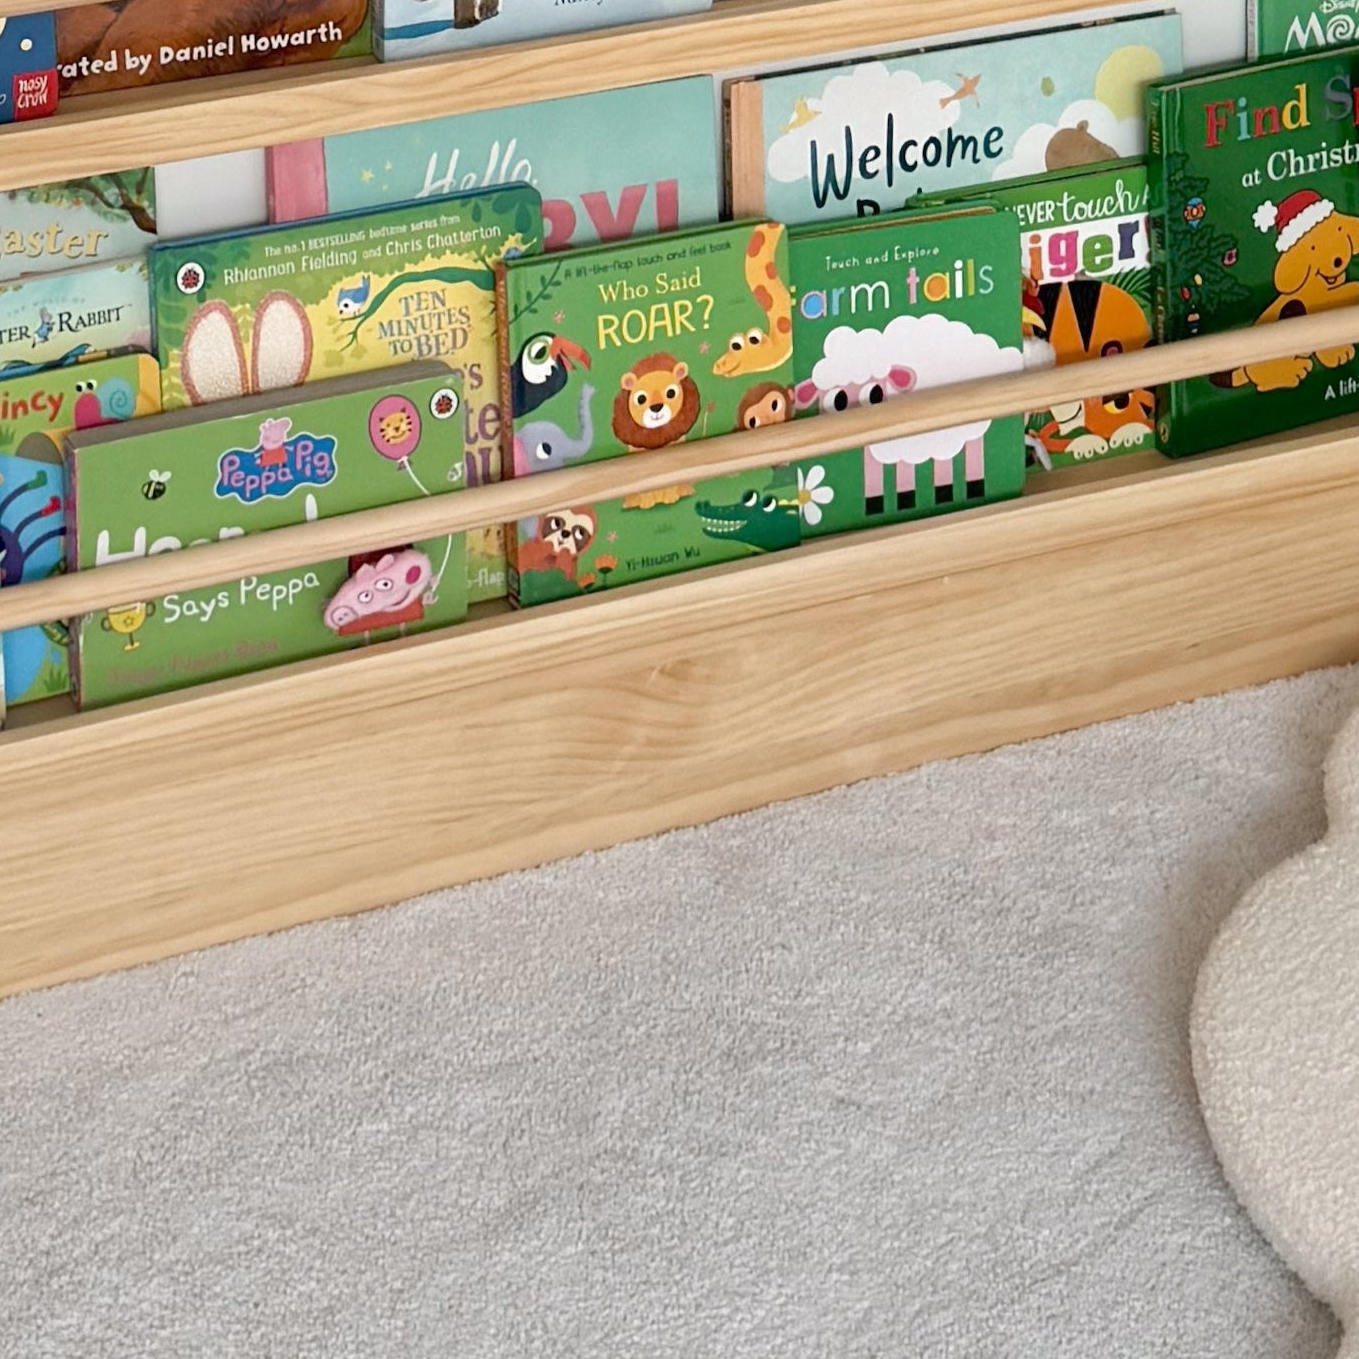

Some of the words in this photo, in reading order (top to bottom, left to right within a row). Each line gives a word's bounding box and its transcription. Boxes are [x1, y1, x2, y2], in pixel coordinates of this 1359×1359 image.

[125, 46, 153, 76] by
[158, 35, 235, 65] Daniel
[240, 22, 343, 53] Howarth
[1241, 170, 1261, 188] at
[223, 259, 297, 285] Rhiannon
[300, 249, 358, 277] Fielding
[362, 246, 383, 259] and
[386, 241, 423, 258] Chris
[427, 222, 502, 253] Chatterton
[825, 253, 861, 273] Touch
[864, 252, 889, 268] and
[894, 245, 939, 264] Explore
[597, 280, 650, 305] Who
[655, 266, 702, 297] Said
[398, 288, 447, 317] TEN
[56, 305, 124, 334] RABBIT
[388, 337, 413, 357] TO
[413, 328, 470, 360] BED
[627, 553, 680, 573] Yi-Hsuan
[683, 547, 701, 562] Wu
[162, 591, 229, 623] Says
[239, 571, 321, 607] Peppa
